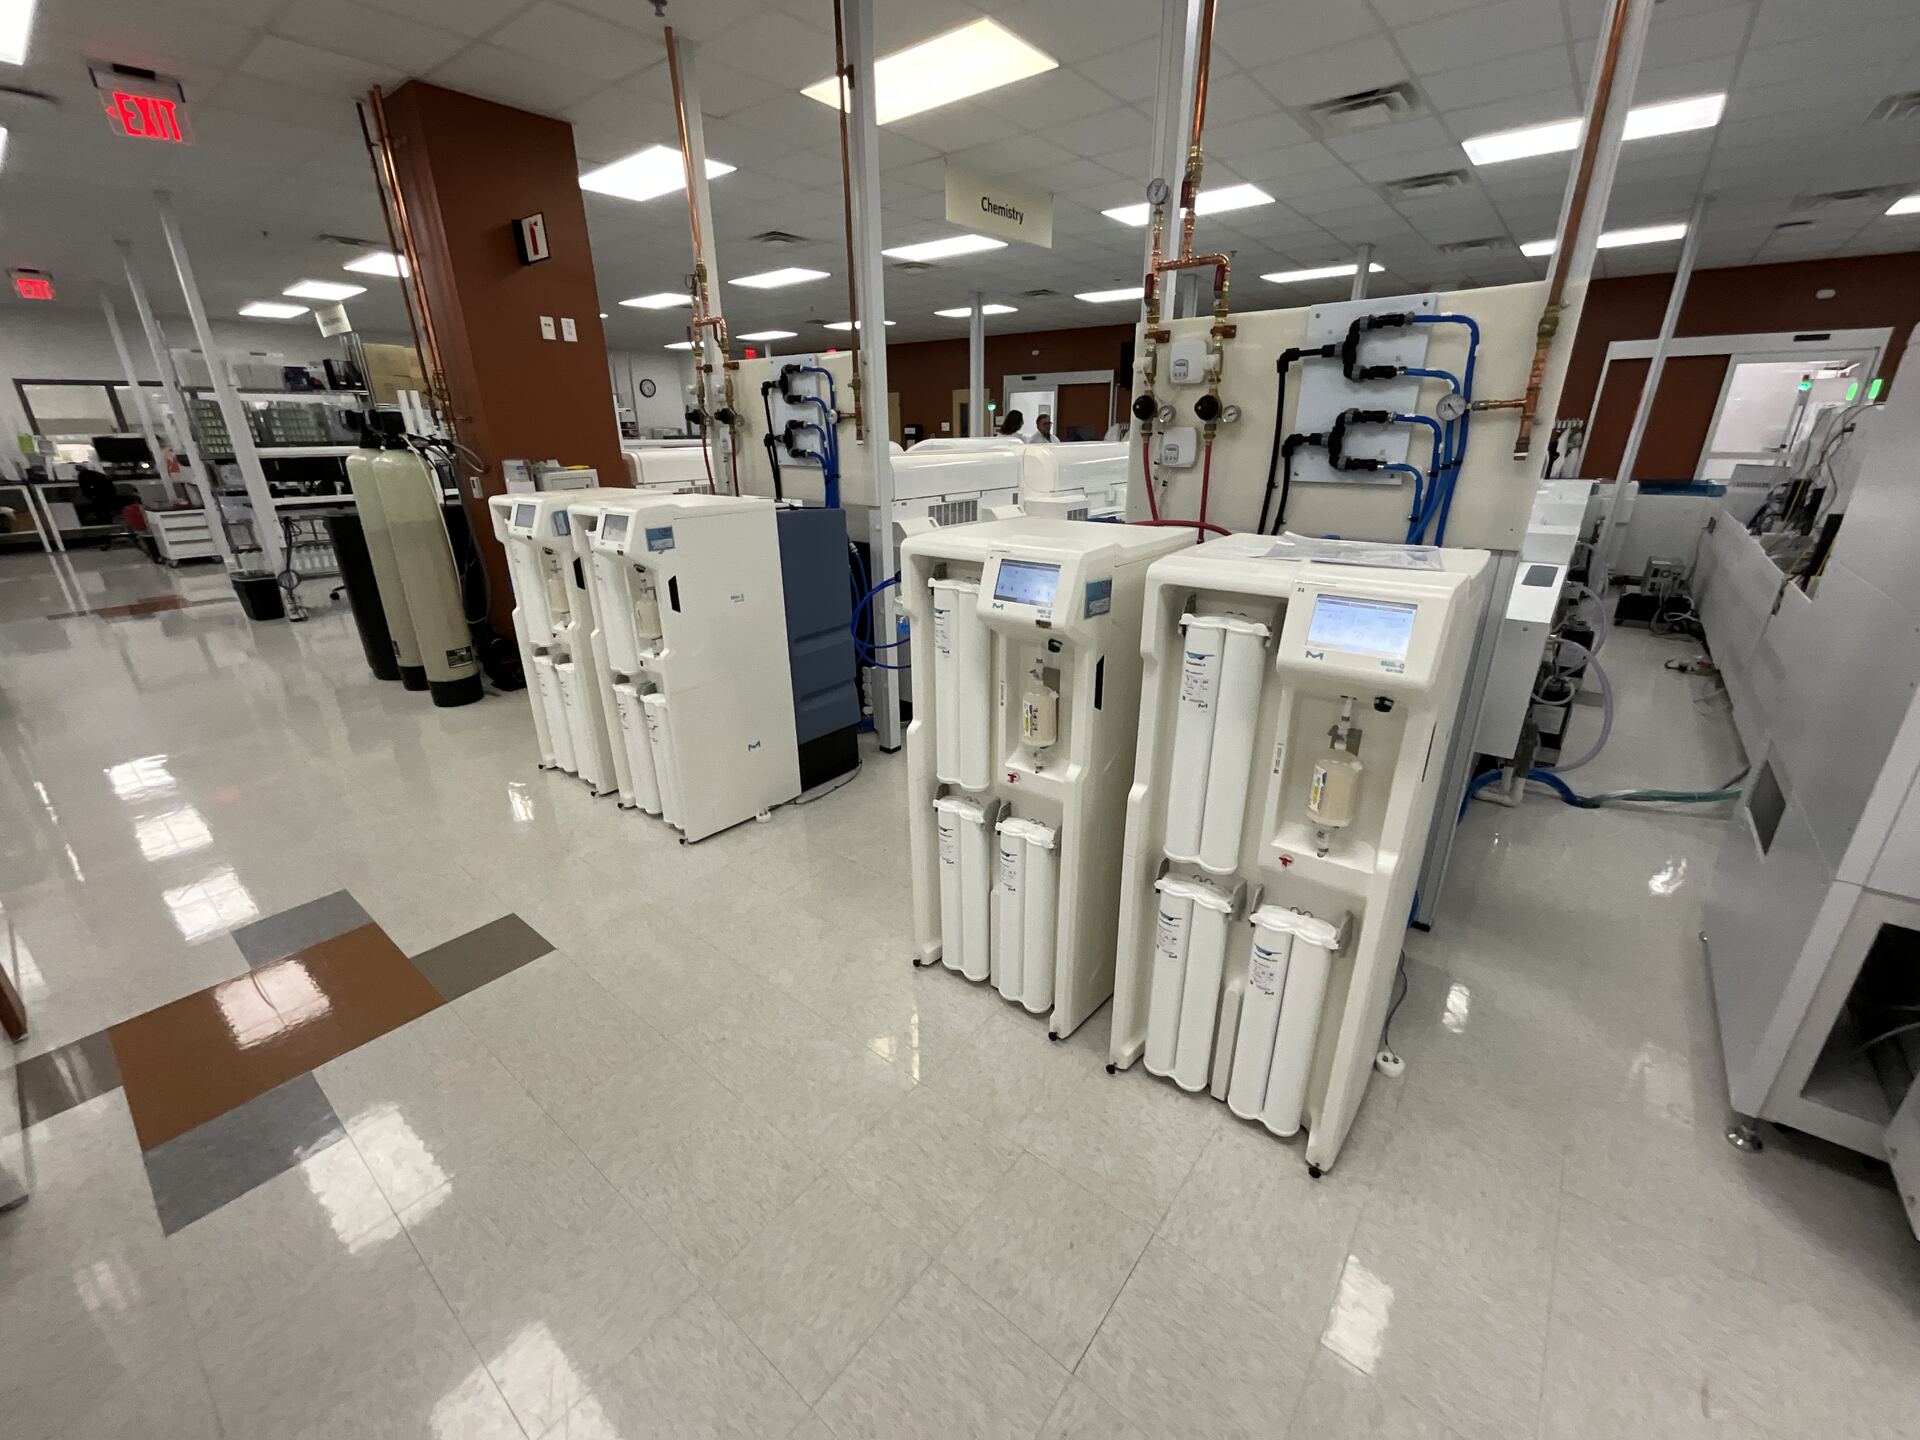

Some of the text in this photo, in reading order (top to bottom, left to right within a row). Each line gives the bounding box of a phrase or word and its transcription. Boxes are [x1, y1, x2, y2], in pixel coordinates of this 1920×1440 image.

[113, 91, 183, 143] EXIT
[981, 196, 1024, 225] Chemistry
[16, 278, 53, 300] EXIT
